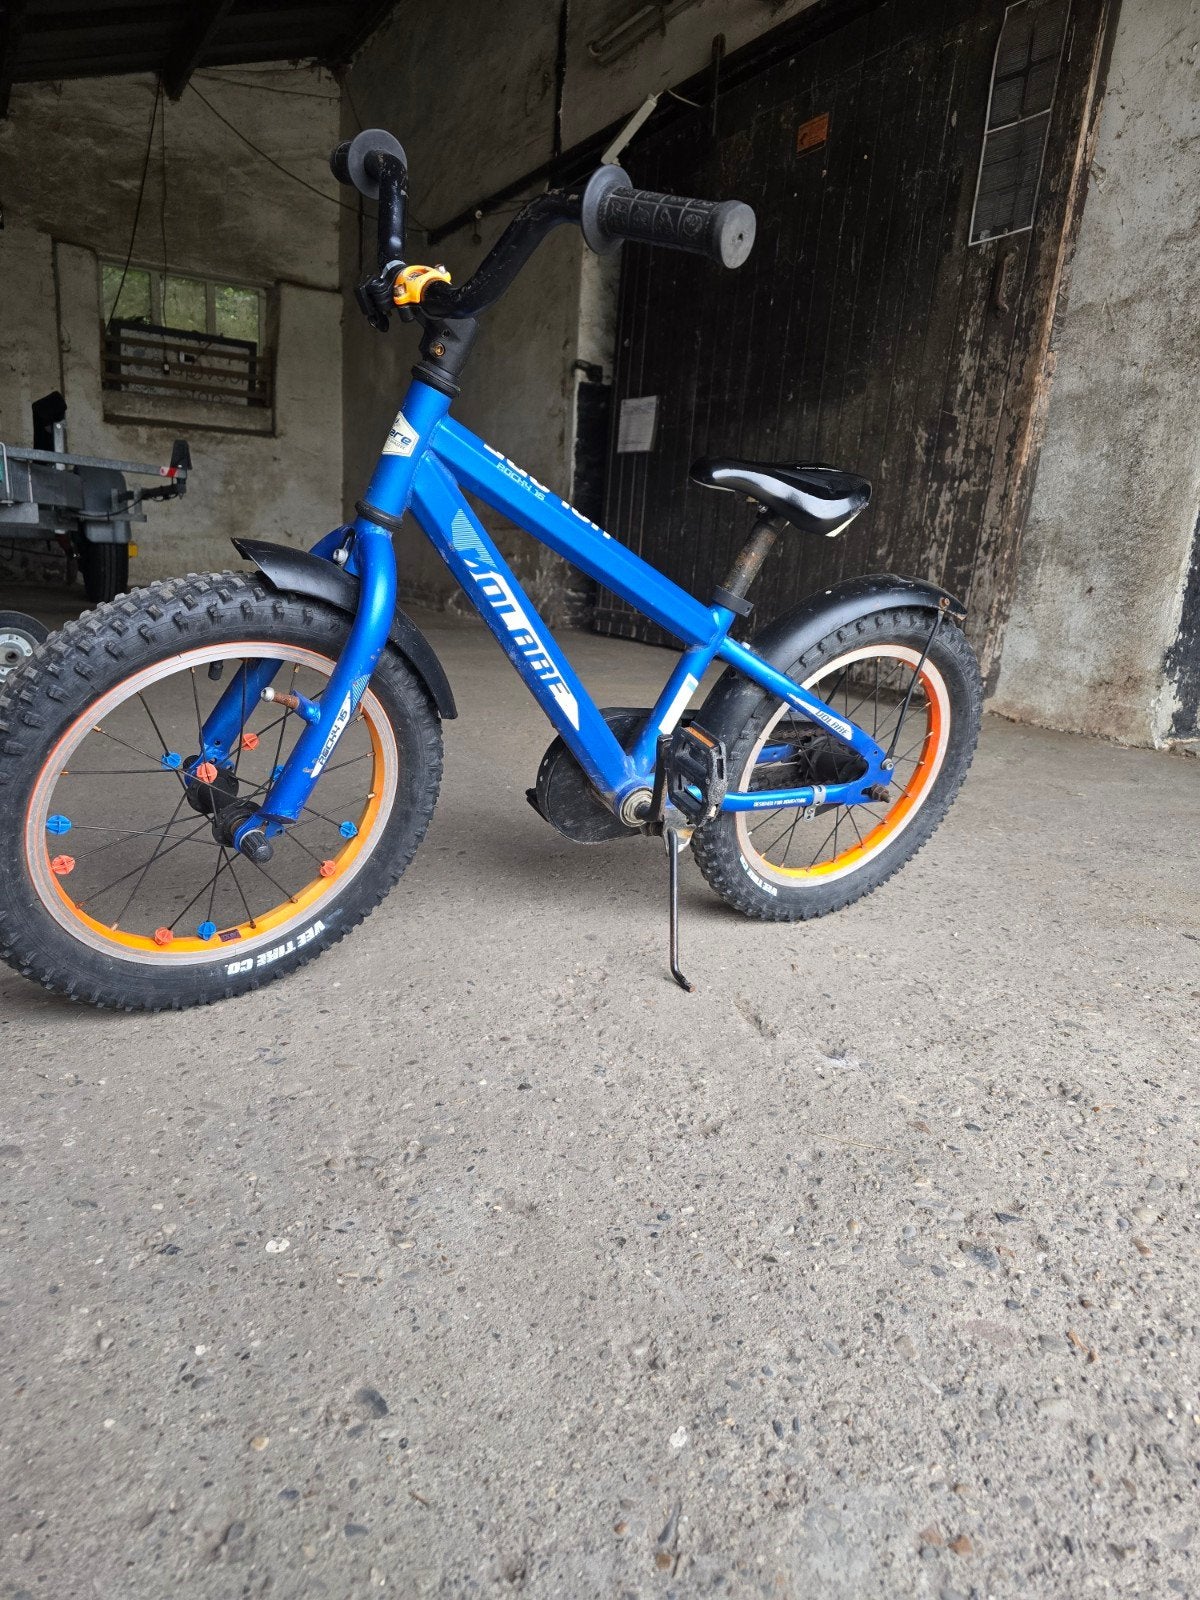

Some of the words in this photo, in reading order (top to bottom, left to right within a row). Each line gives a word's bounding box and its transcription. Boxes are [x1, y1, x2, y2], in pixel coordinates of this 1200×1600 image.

[496, 461, 532, 493] ROCKY
[320, 725, 341, 766] ROCKY
[297, 919, 326, 948] VEE
[256, 940, 297, 967] TIRE
